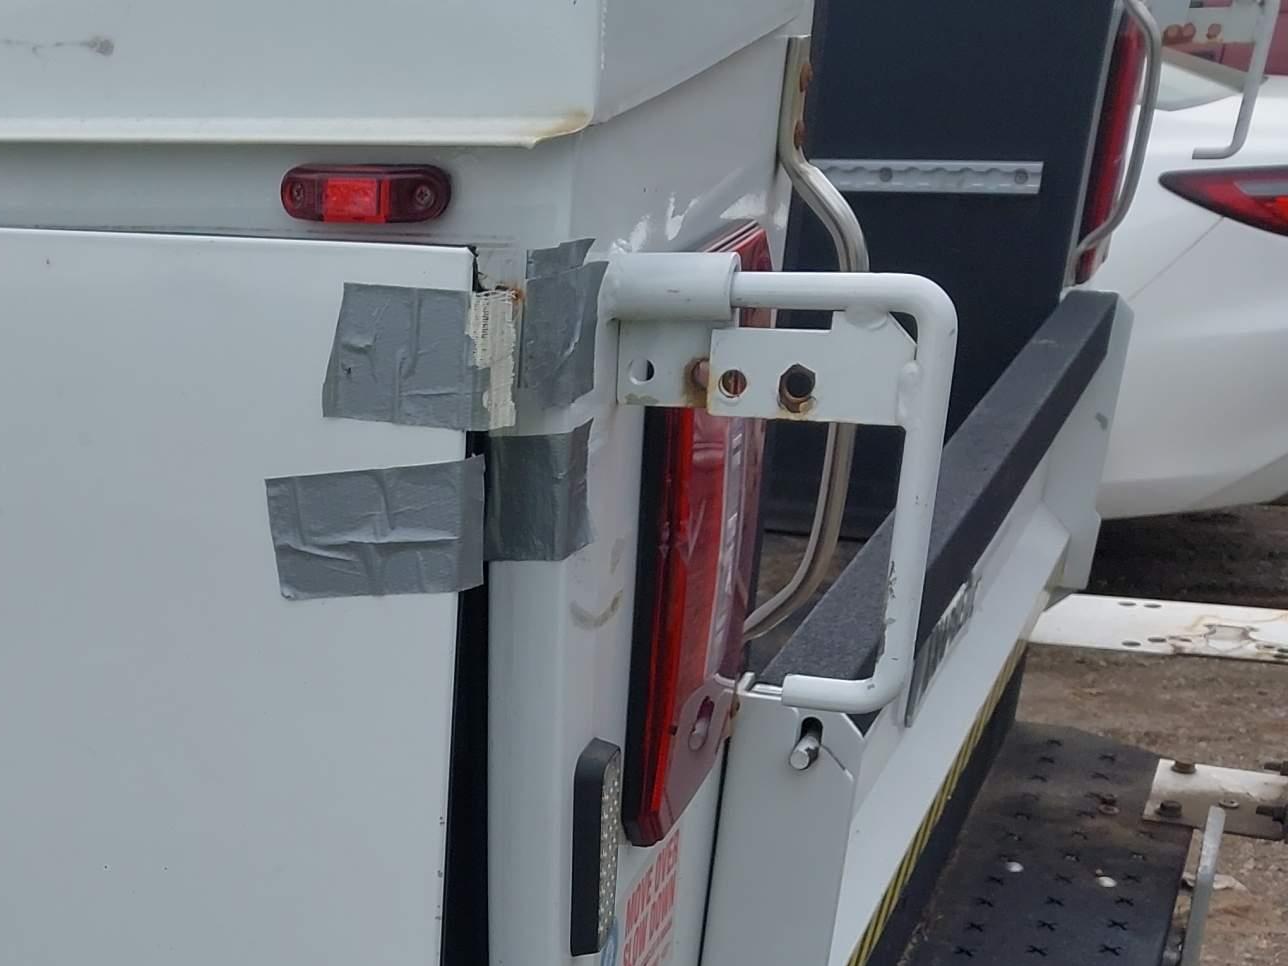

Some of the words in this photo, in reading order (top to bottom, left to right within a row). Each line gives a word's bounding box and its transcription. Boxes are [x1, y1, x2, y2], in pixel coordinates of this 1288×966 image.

[625, 864, 654, 940] MOVE
[653, 828, 680, 893] OVER
[648, 870, 676, 941] DOWN
